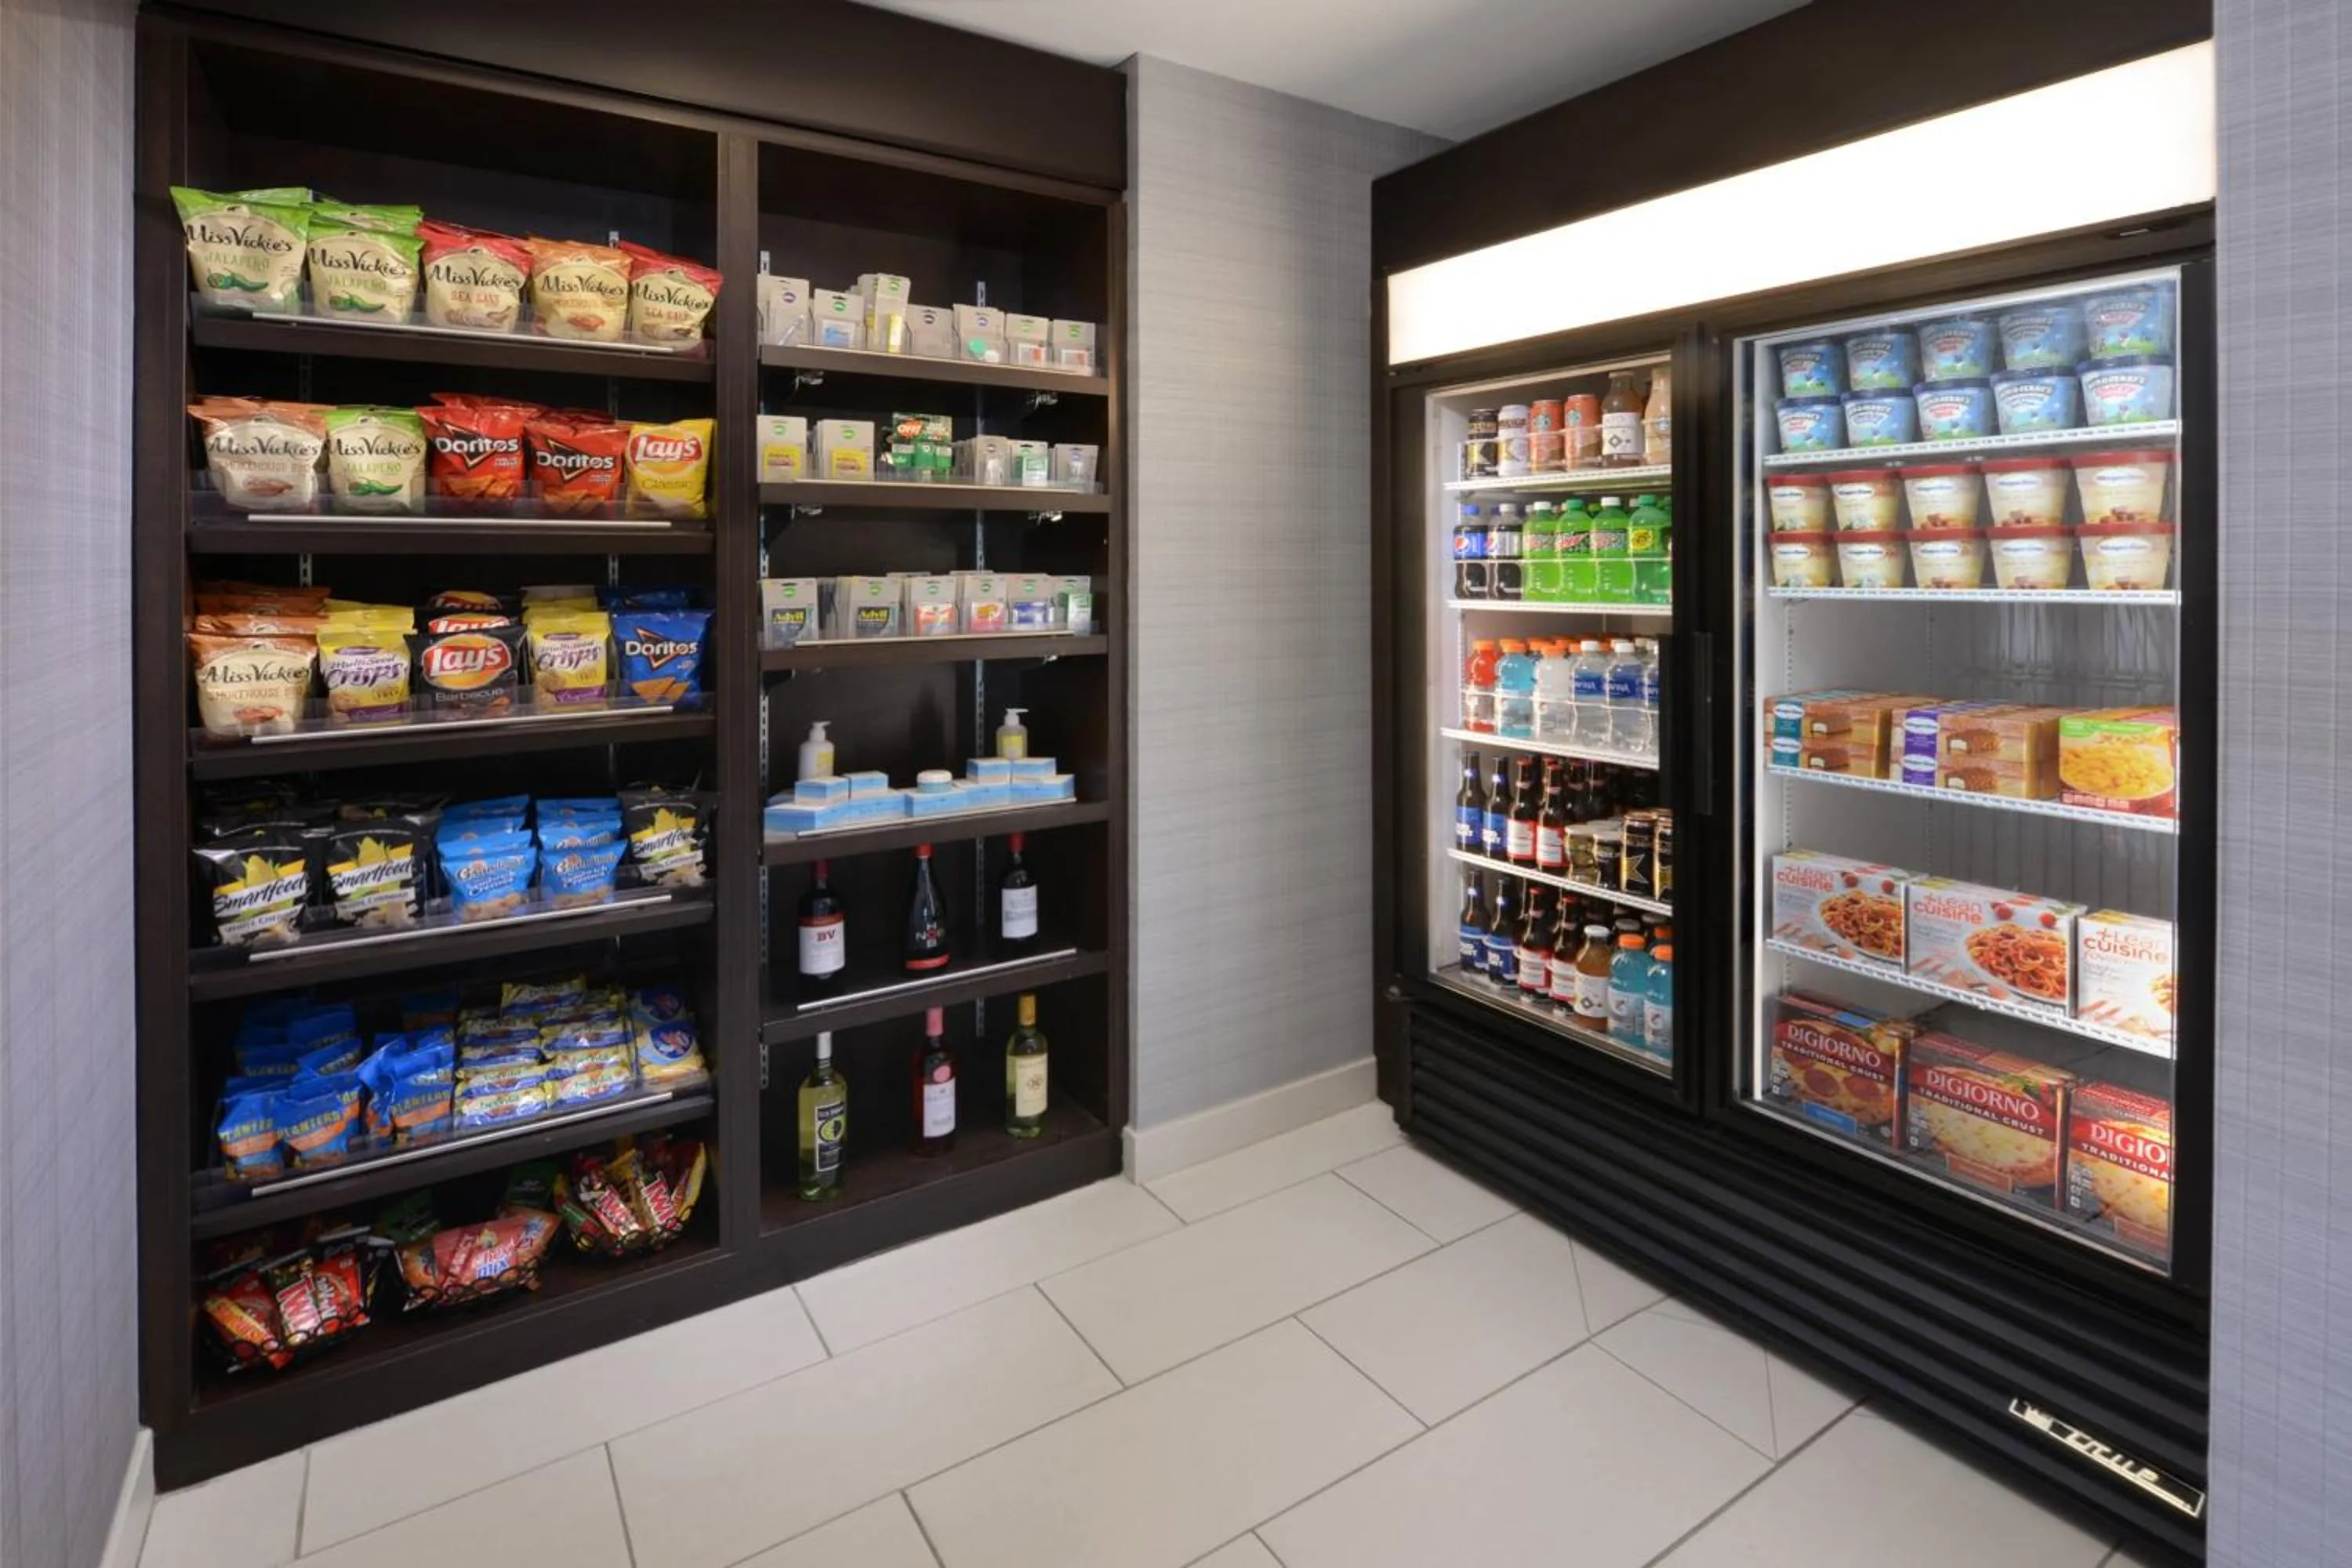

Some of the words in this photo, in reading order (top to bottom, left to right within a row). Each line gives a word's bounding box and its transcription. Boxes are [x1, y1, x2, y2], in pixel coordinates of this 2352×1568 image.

[429, 264, 471, 284] Miss
[539, 274, 579, 292] Miss
[435, 437, 519, 454] Doritos
[535, 451, 615, 470] Doritos
[625, 640, 698, 658] Doritos
[199, 665, 252, 684] Miss
[816, 928, 837, 942] BV
[1787, 1024, 1882, 1069] DIGIORNO
[1781, 1040, 1846, 1071] TRADITIONAL
[1849, 1065, 1886, 1081] CRUST
[1926, 1069, 2039, 1121] DIGIORNO
[1920, 1087, 1999, 1122] TRADITIONAL
[2002, 1116, 2045, 1136] CRUST
